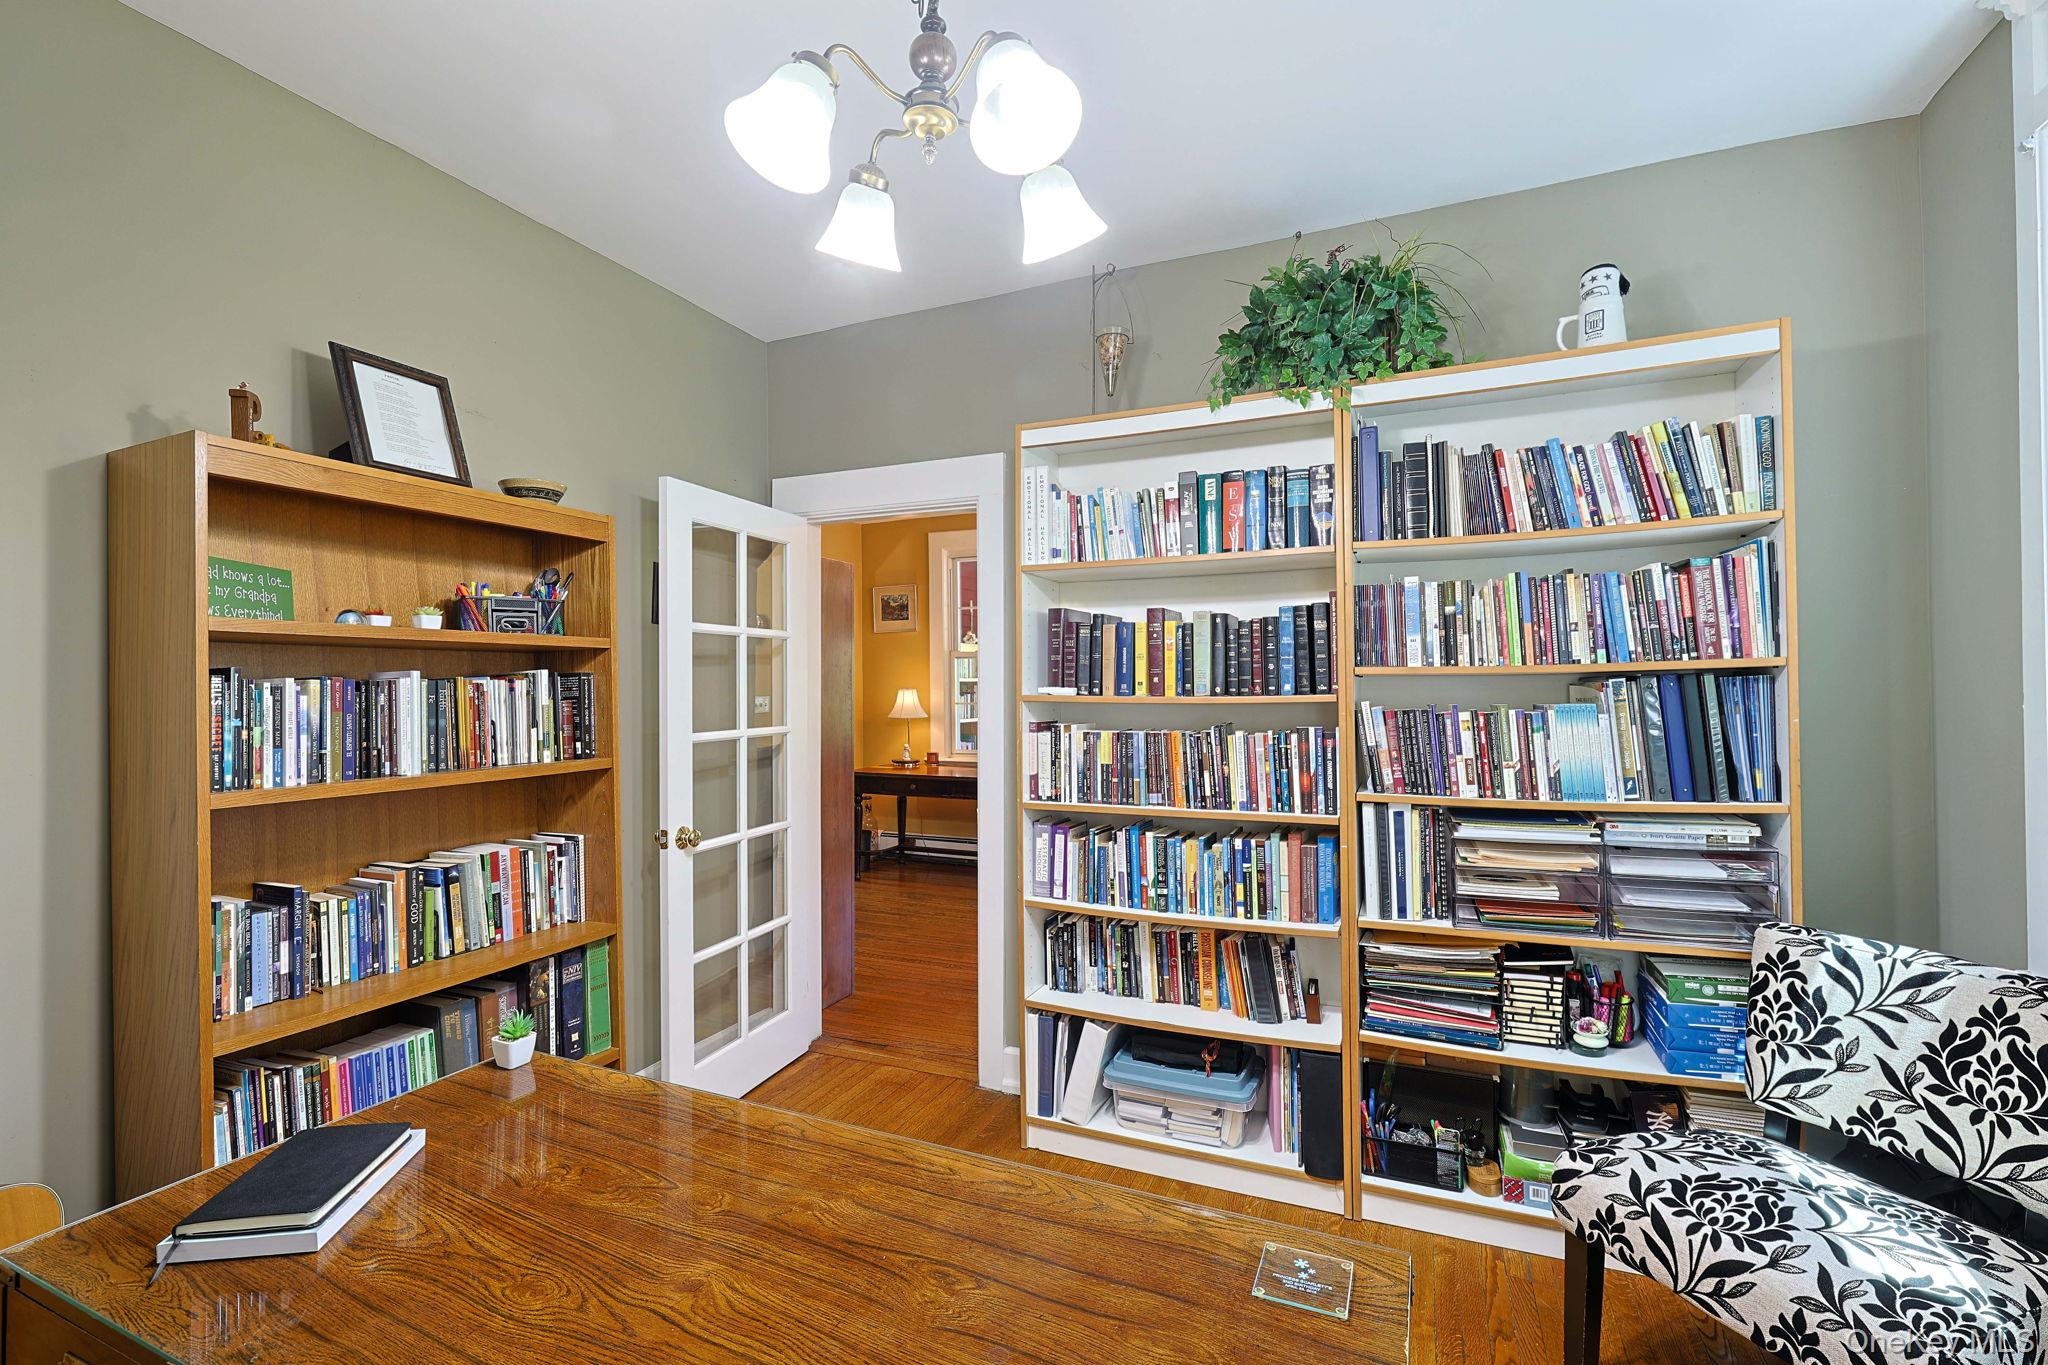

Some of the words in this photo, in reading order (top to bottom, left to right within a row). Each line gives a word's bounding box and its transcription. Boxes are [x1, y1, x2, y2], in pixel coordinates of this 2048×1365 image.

[1760, 420, 1771, 451] KNOWING
[1576, 453, 1584, 470] ABLAZE
[1591, 448, 1599, 465] REVIVAL
[1676, 441, 1684, 456] FAITH
[1685, 472, 1693, 490] POWER
[1762, 452, 1771, 468] GOD
[1207, 480, 1215, 500] VINE
[1641, 483, 1649, 495] WORLD
[1763, 471, 1774, 497] PACKER
[1764, 498, 1774, 510] IVP
[223, 566, 253, 583] knows
[257, 574, 267, 586] a
[1695, 570, 1704, 598] SPIRITUAL
[1701, 569, 1710, 580] THE
[216, 586, 230, 599] my
[234, 586, 277, 605] Grandpa
[1702, 580, 1714, 611] HANDBOOK
[1594, 604, 1602, 625] DARKNESS
[1698, 598, 1707, 622] WARFARE
[1706, 611, 1715, 624] FOR
[1661, 614, 1669, 630] Spirits
[1704, 627, 1712, 645] MURPHY
[211, 677, 223, 705] HELL'S
[439, 690, 447, 711] Faith
[1619, 712, 1627, 730] Growing
[211, 715, 222, 752] SECRET
[1665, 833, 1687, 841] Granite
[1687, 834, 1705, 842] Paper
[500, 854, 508, 880] ANYWAY
[294, 897, 302, 929] MARGIN
[410, 904, 419, 925] GOD
[1201, 932, 1212, 958] CHRISTIAN
[567, 963, 583, 975] NIV
[1202, 958, 1212, 990] COUNSELING
[450, 1013, 456, 1024] TO
[454, 1010, 462, 1040] THINGS
[1272, 1273, 1299, 1283] PRINCESS
[1294, 1282, 1321, 1291] BIRTHDAY
